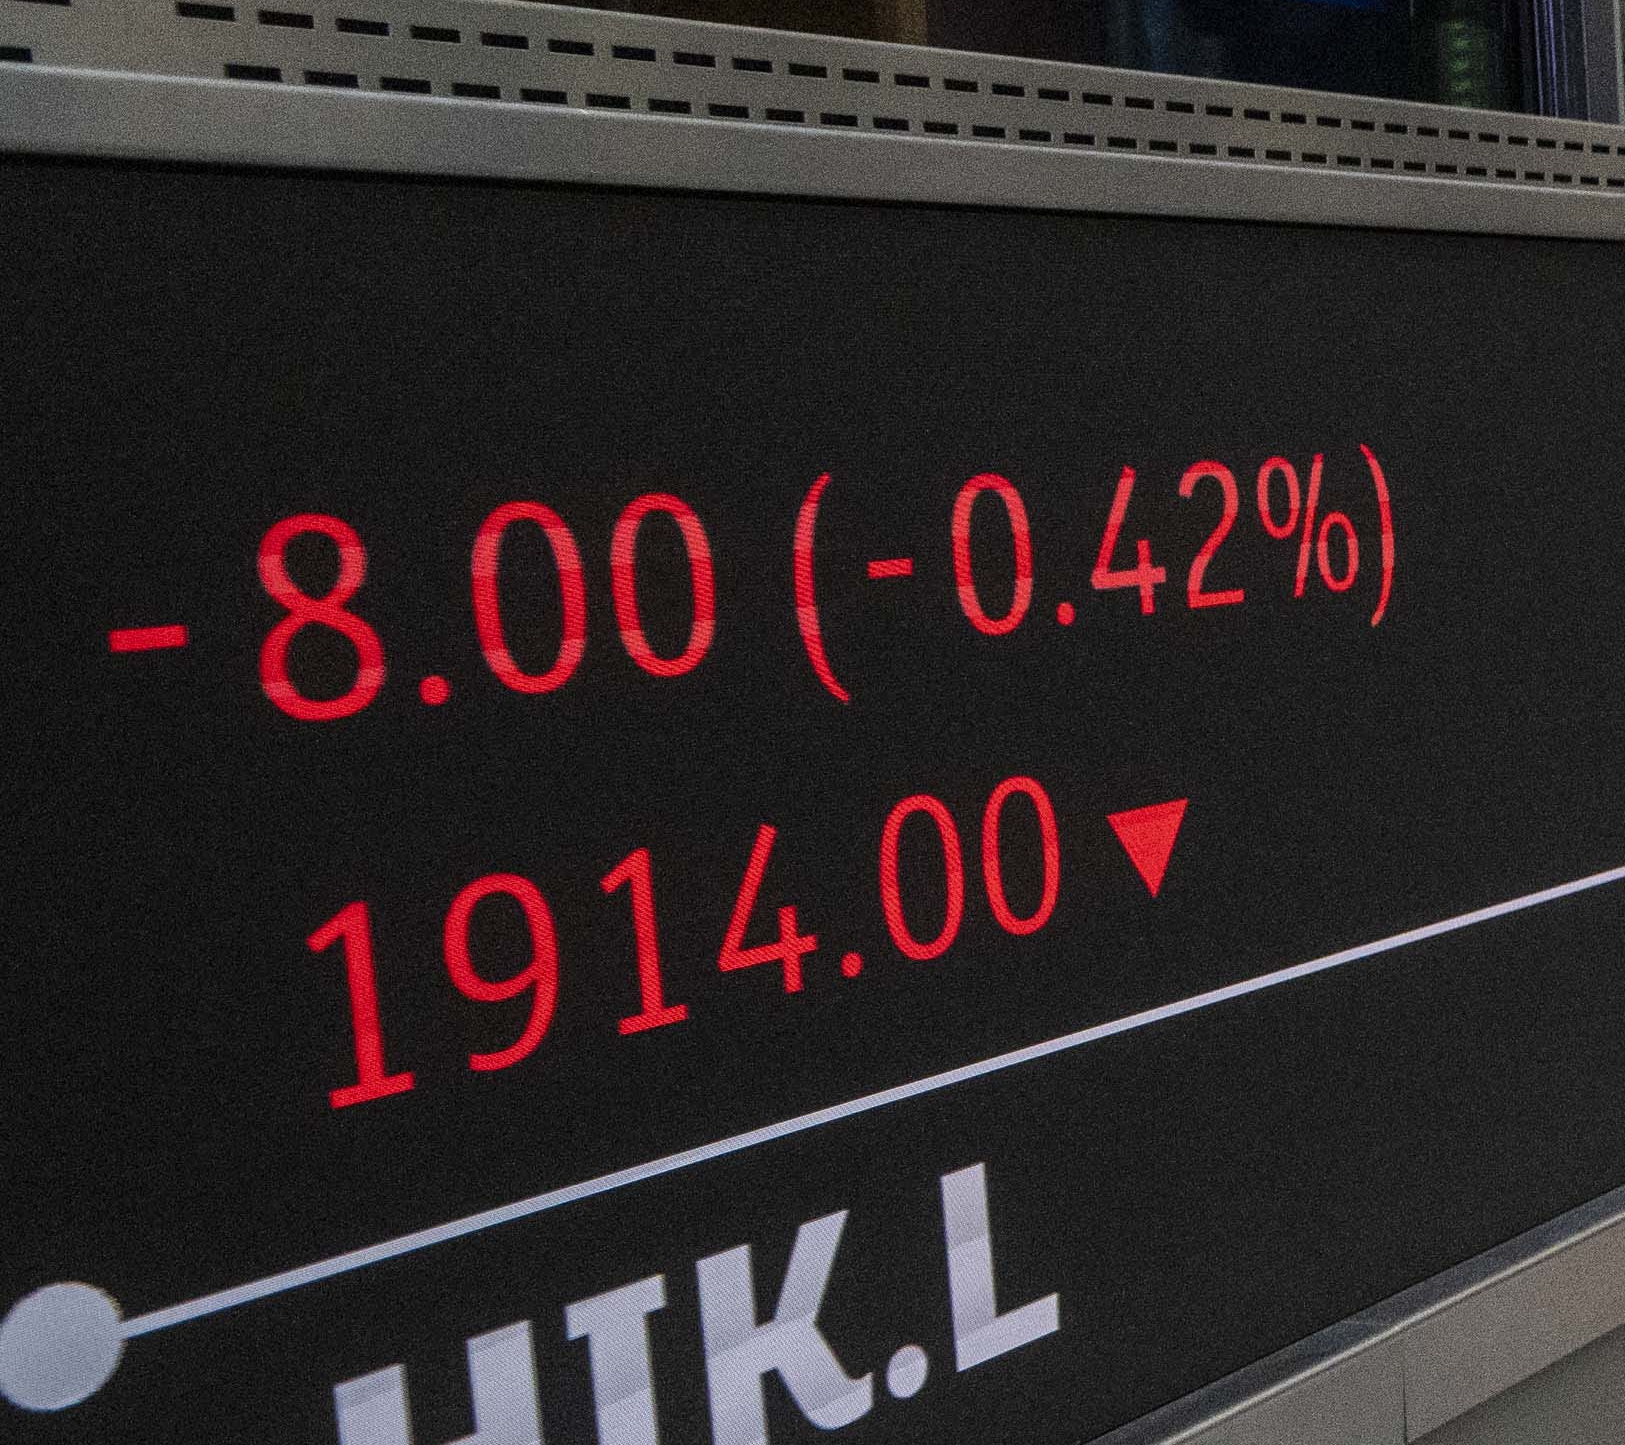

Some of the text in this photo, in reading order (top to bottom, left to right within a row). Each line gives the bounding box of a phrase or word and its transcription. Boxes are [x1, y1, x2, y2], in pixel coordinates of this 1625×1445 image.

[110, 445, 1395, 720] -8.00 (-0.42%)
[306, 776, 1063, 1111] 1914.00
